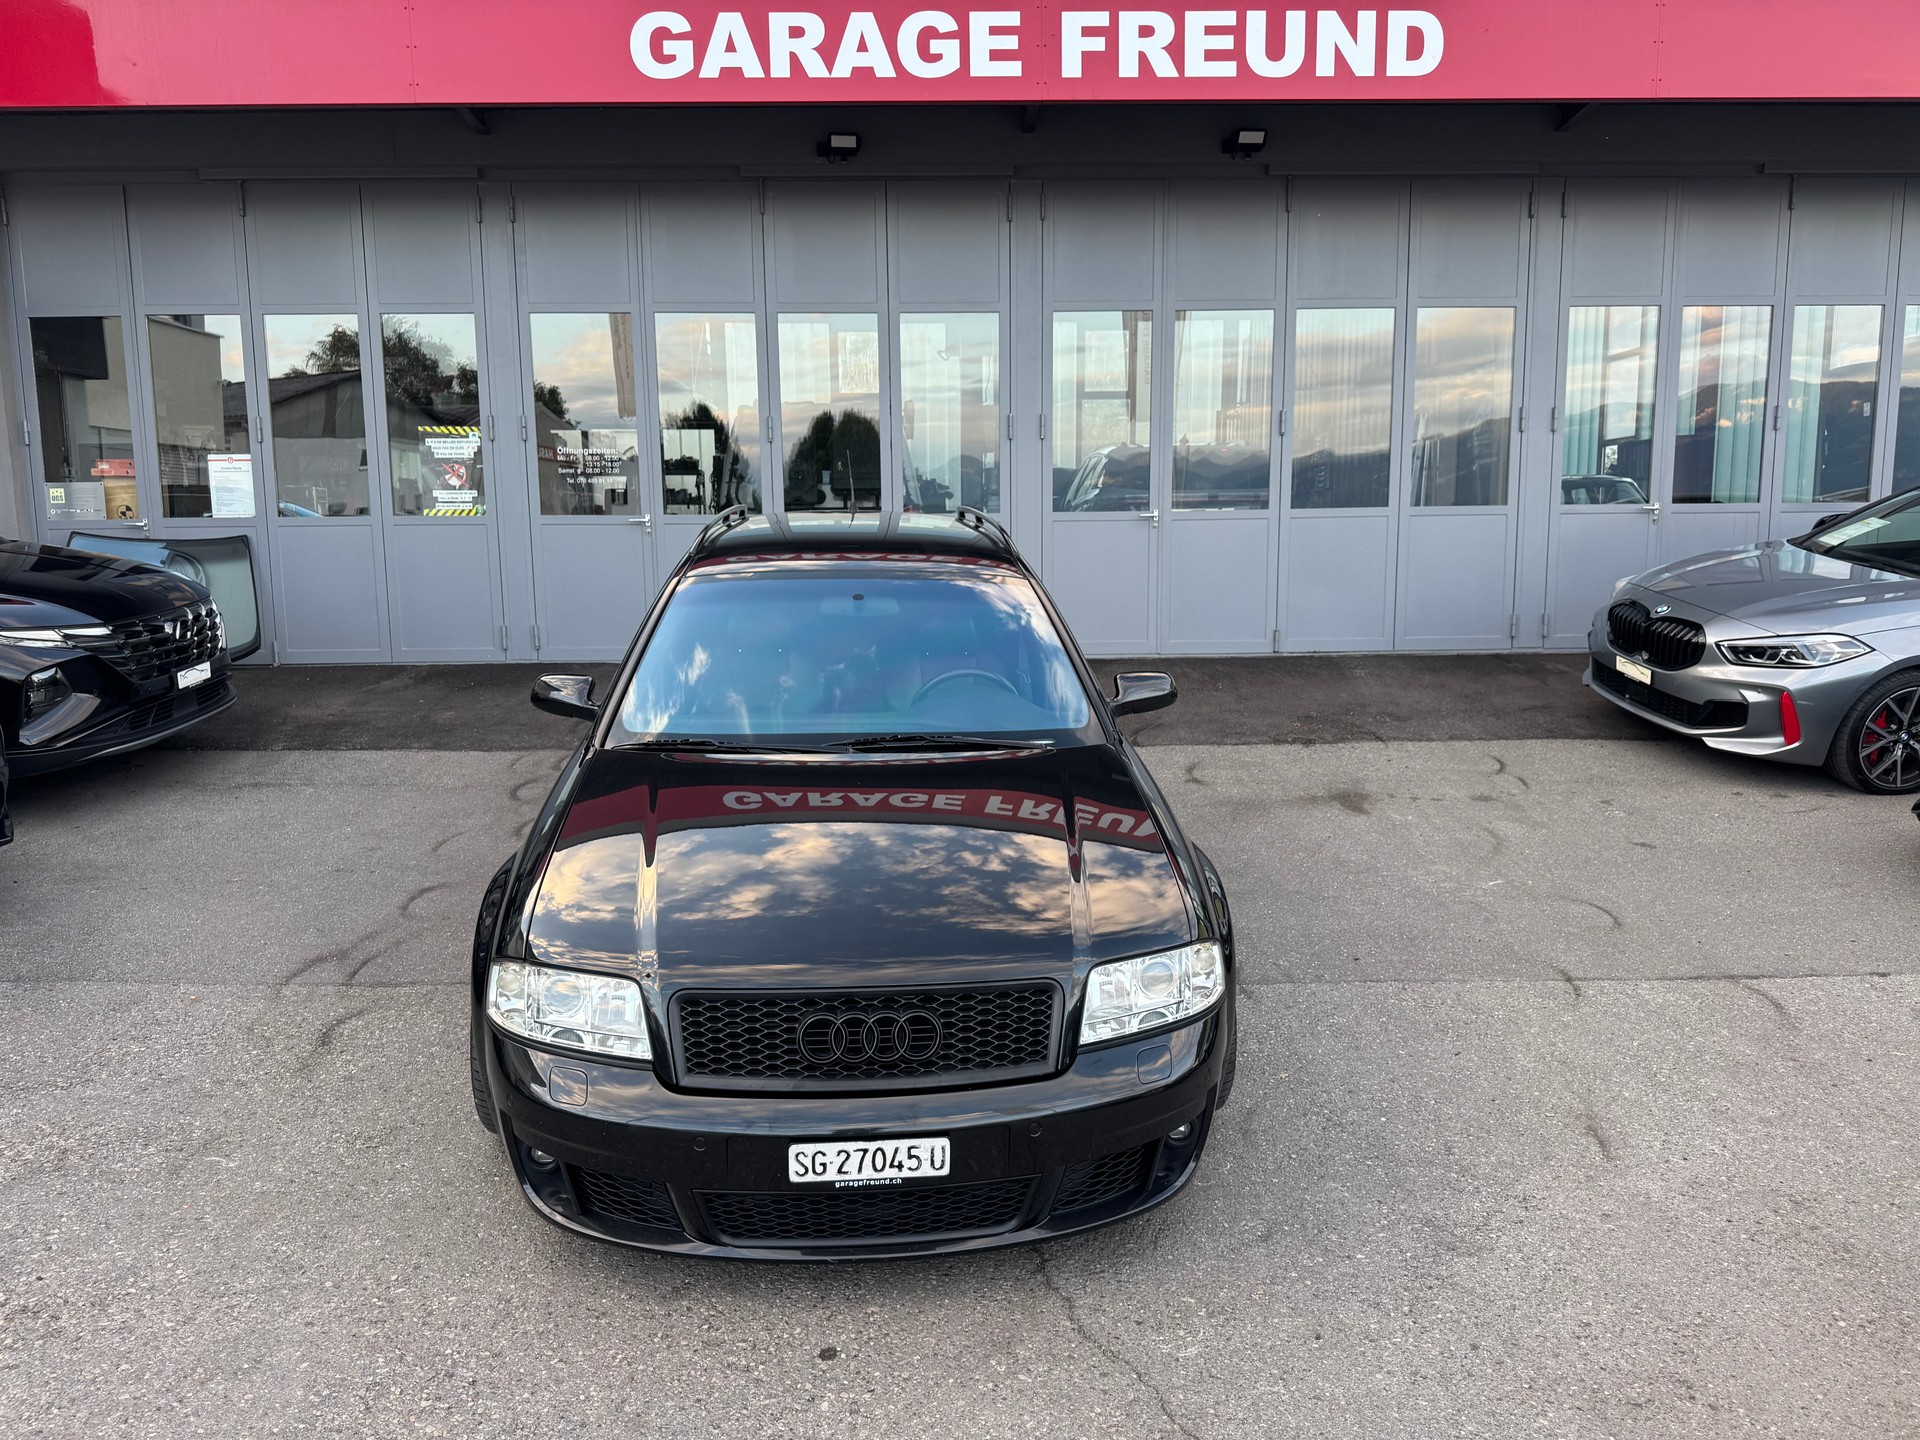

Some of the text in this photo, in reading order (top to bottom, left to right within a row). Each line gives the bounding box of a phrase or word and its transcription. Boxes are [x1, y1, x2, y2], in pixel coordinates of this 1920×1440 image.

[629, 10, 1444, 80] GARAGE FREUND
[557, 445, 619, 456] Öffnungszeiten:
[558, 467, 582, 475] Samstg
[51, 494, 64, 502] UGS
[834, 1177, 902, 1188] garagefreund.ch
